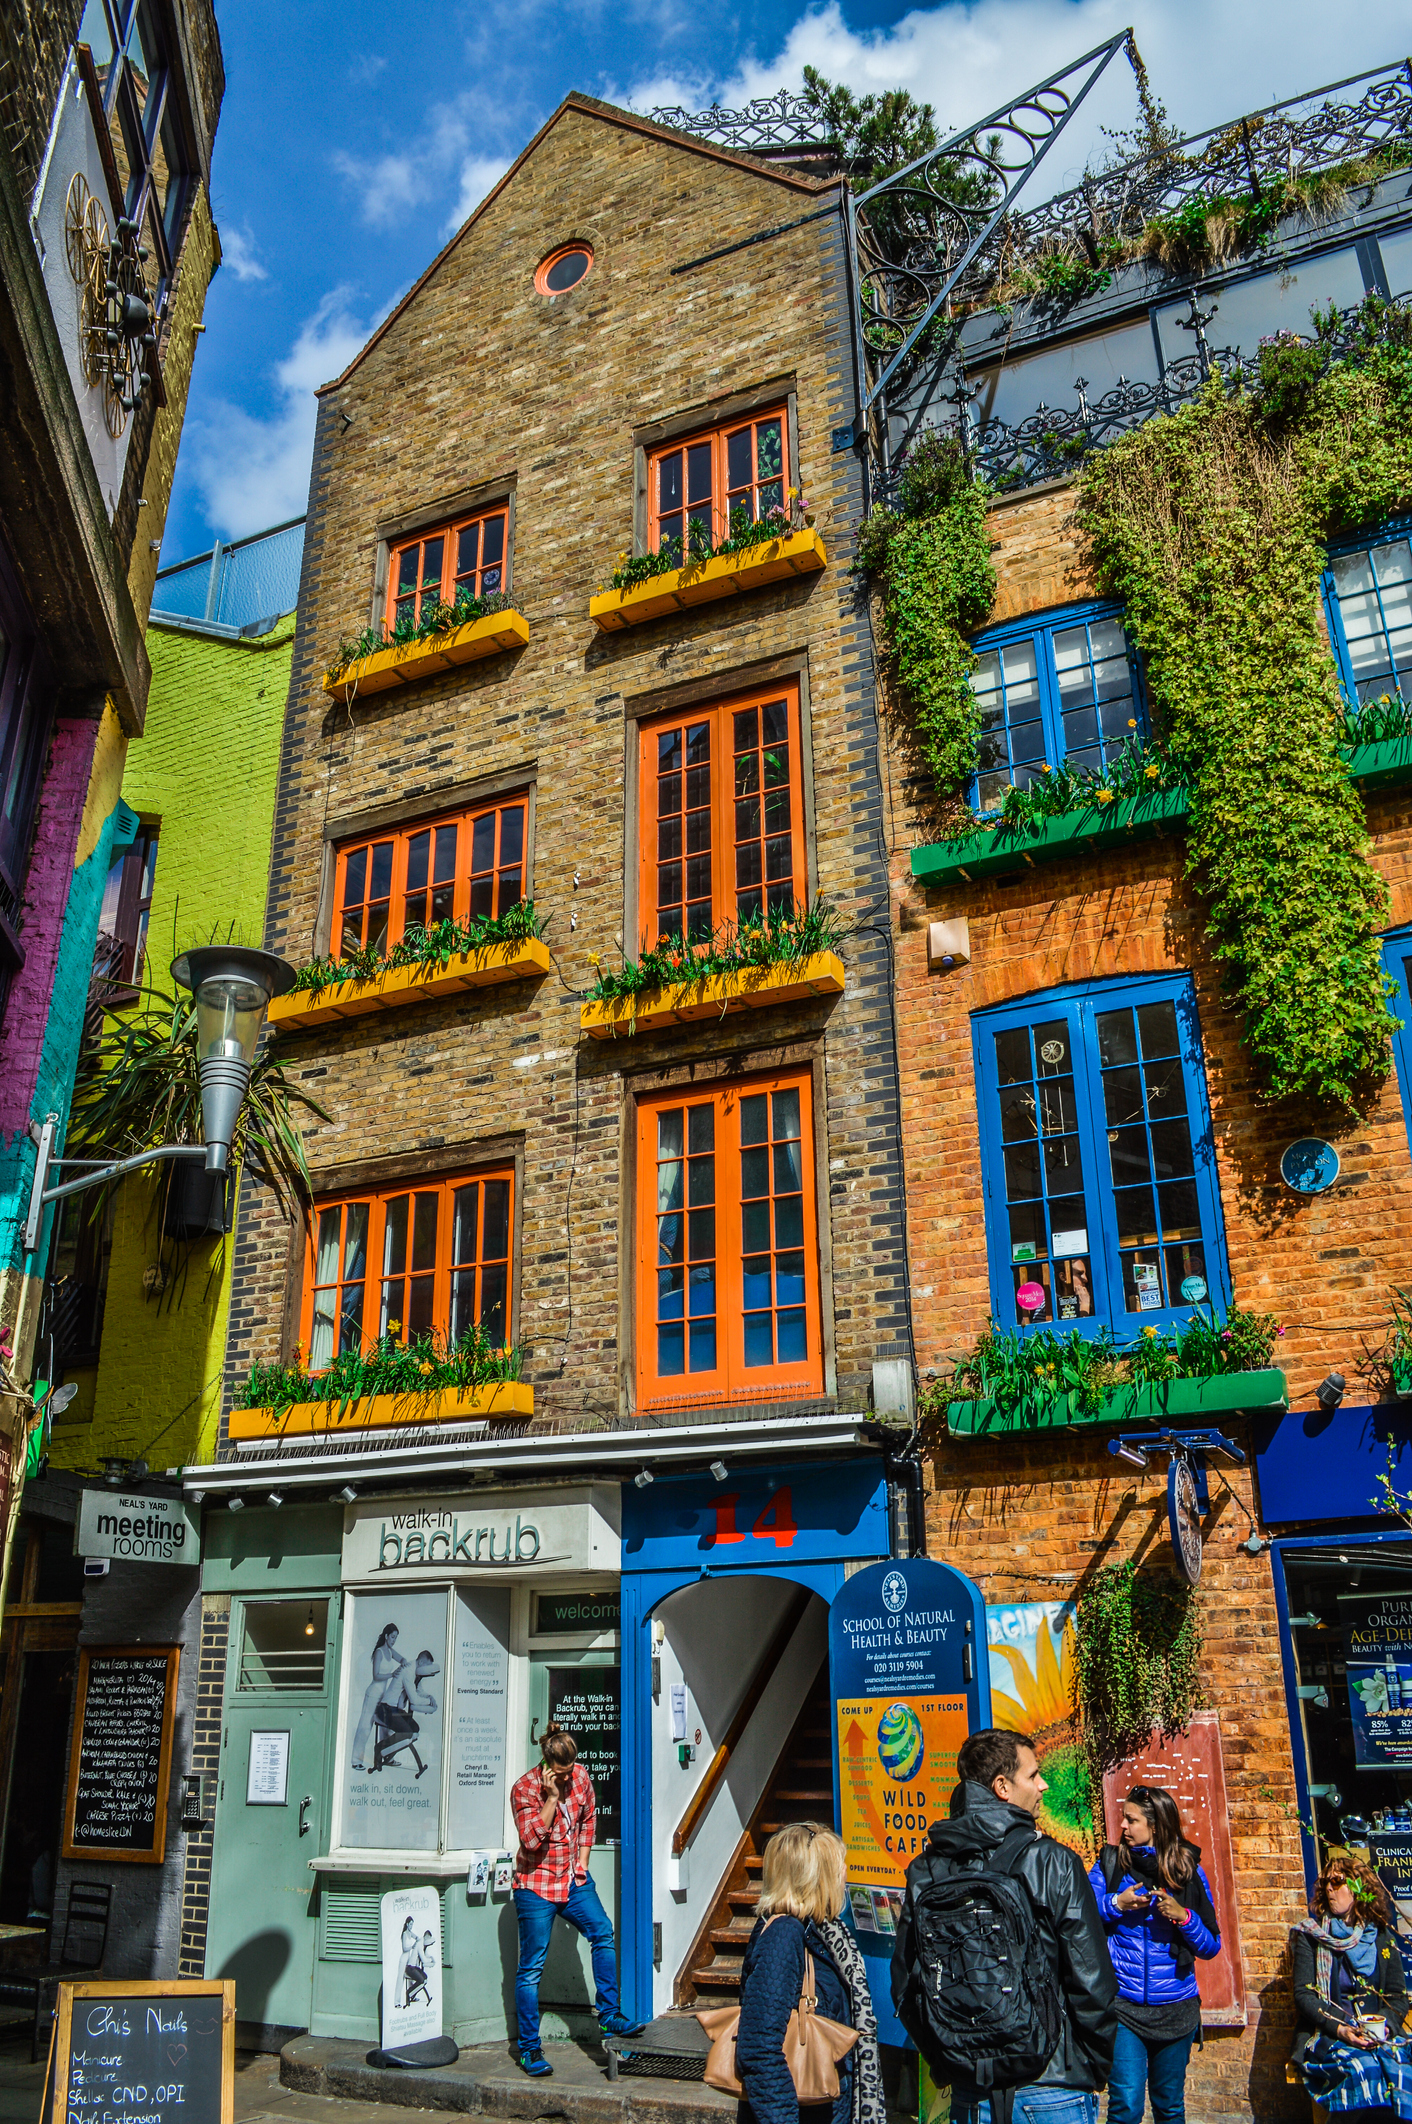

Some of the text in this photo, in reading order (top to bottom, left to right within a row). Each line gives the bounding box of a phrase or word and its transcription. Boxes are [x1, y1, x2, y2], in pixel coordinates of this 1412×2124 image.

[1290, 1157, 1330, 1169] PYTHON
[1141, 1294, 1160, 1302] BEST
[119, 1499, 168, 1511] NEAL'S YARD
[392, 1507, 453, 1530] walk-in
[706, 1485, 798, 1548] 14
[97, 1514, 185, 1547] meeting
[379, 1515, 541, 1568] backrub
[113, 1537, 173, 1558] rooms
[1382, 1601, 1412, 1613] PUR
[843, 1609, 955, 1633] SCHOOL OF NATURAL
[851, 1628, 947, 1649] HEALTH & BEAUTY
[1352, 1643, 1401, 1653] BEAUTY with
[874, 1660, 924, 1673] 020 3119 5904
[563, 1694, 613, 1703] At the Walk-in
[556, 1704, 587, 1713] Backrub,
[590, 1705, 603, 1714] you
[842, 1707, 860, 1715] COME
[921, 1703, 964, 1712] 1ST FLOOR
[553, 1712, 605, 1722] literally walk in
[570, 1722, 582, 1731] rub
[585, 1723, 601, 1732] your
[1371, 1720, 1389, 1729] 85%
[590, 1750, 617, 1759] to book
[149, 1755, 158, 1766] 20
[592, 1763, 607, 1771] take
[598, 1772, 610, 1780] off
[350, 1784, 369, 1793] walk
[384, 1784, 393, 1793] sit
[396, 1784, 422, 1796] down,
[350, 1797, 431, 1810] walk out, feel great.
[883, 1788, 926, 1808] WILD
[602, 1805, 612, 1814] in!
[143, 1811, 154, 1822] 20
[884, 1813, 927, 1831] FOOD
[846, 1844, 880, 1852] SANDWICHES
[867, 1866, 896, 1875] EVERYDAY
[86, 2006, 188, 2037] Chi's Nails
[72, 2050, 123, 2067] Manicure
